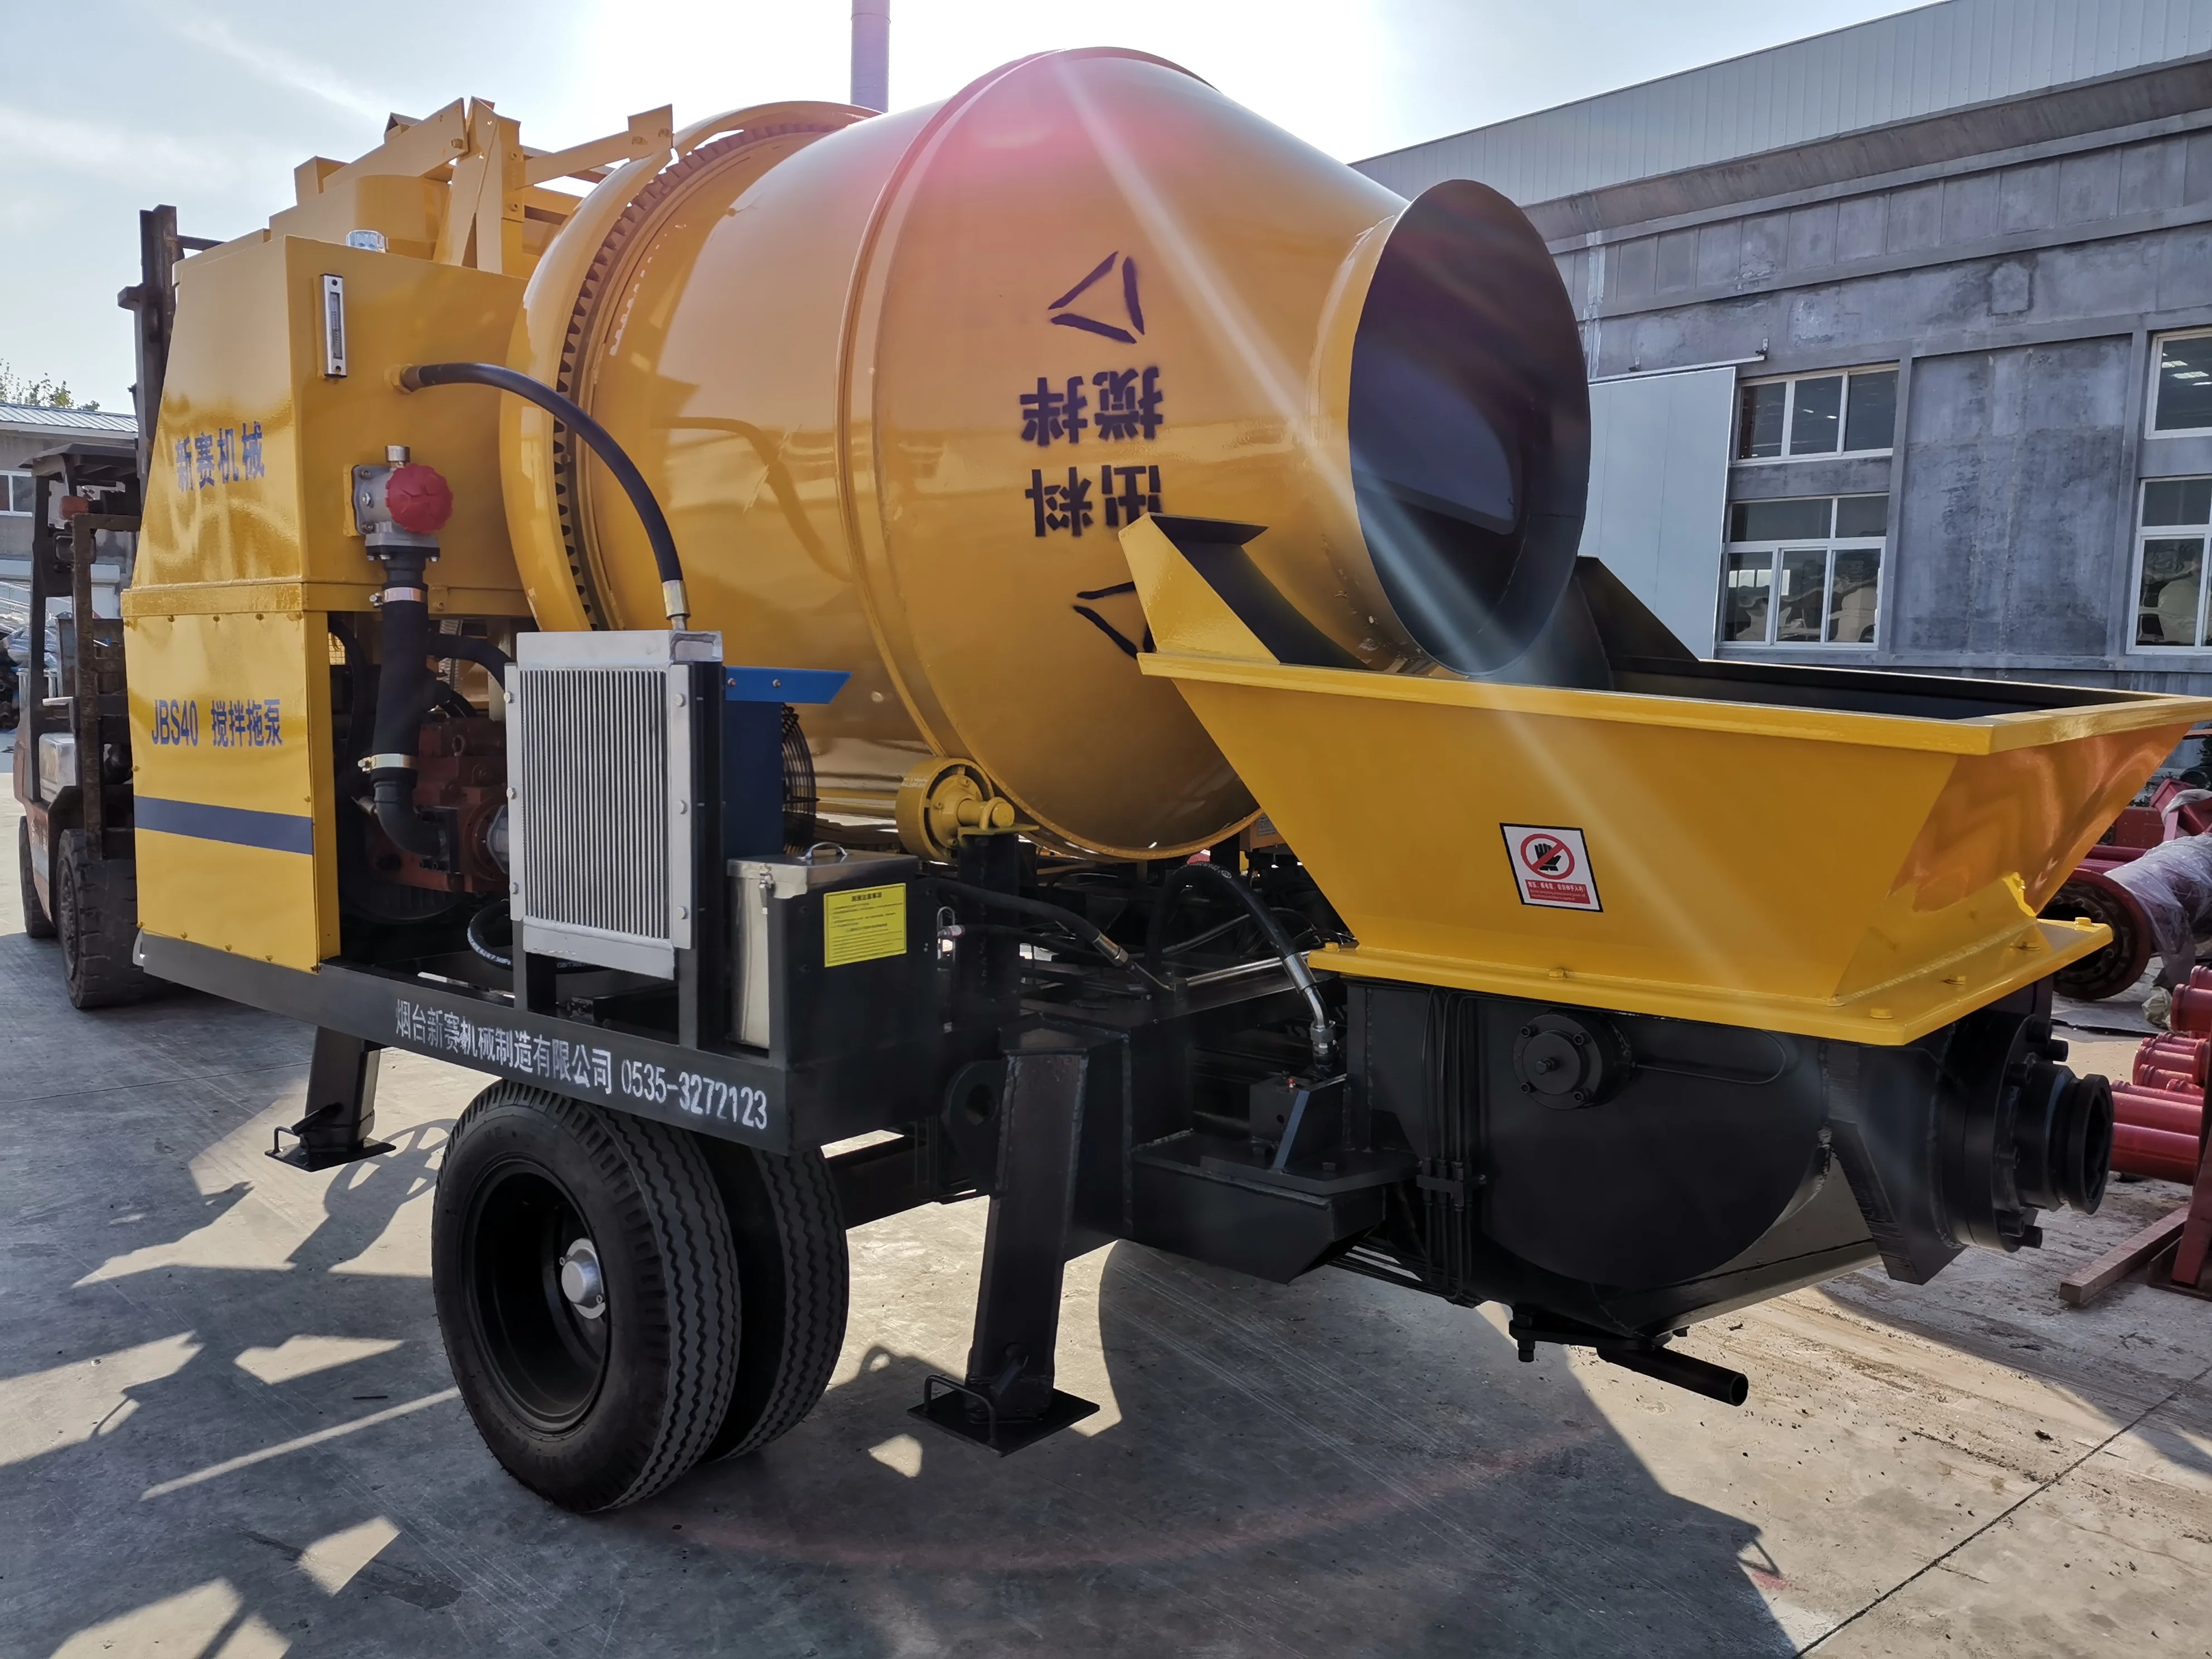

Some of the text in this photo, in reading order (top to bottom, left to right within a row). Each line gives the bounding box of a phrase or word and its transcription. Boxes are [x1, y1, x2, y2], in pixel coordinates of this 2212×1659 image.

[1020, 366, 1164, 447] 搅拌
[174, 421, 265, 493] 新赛机械
[1025, 464, 1163, 537] 出料
[151, 698, 283, 748] JBS40 搅拌拖泵
[395, 998, 768, 1130] 烟台新赛机械制造有限公司 0535-3272123
